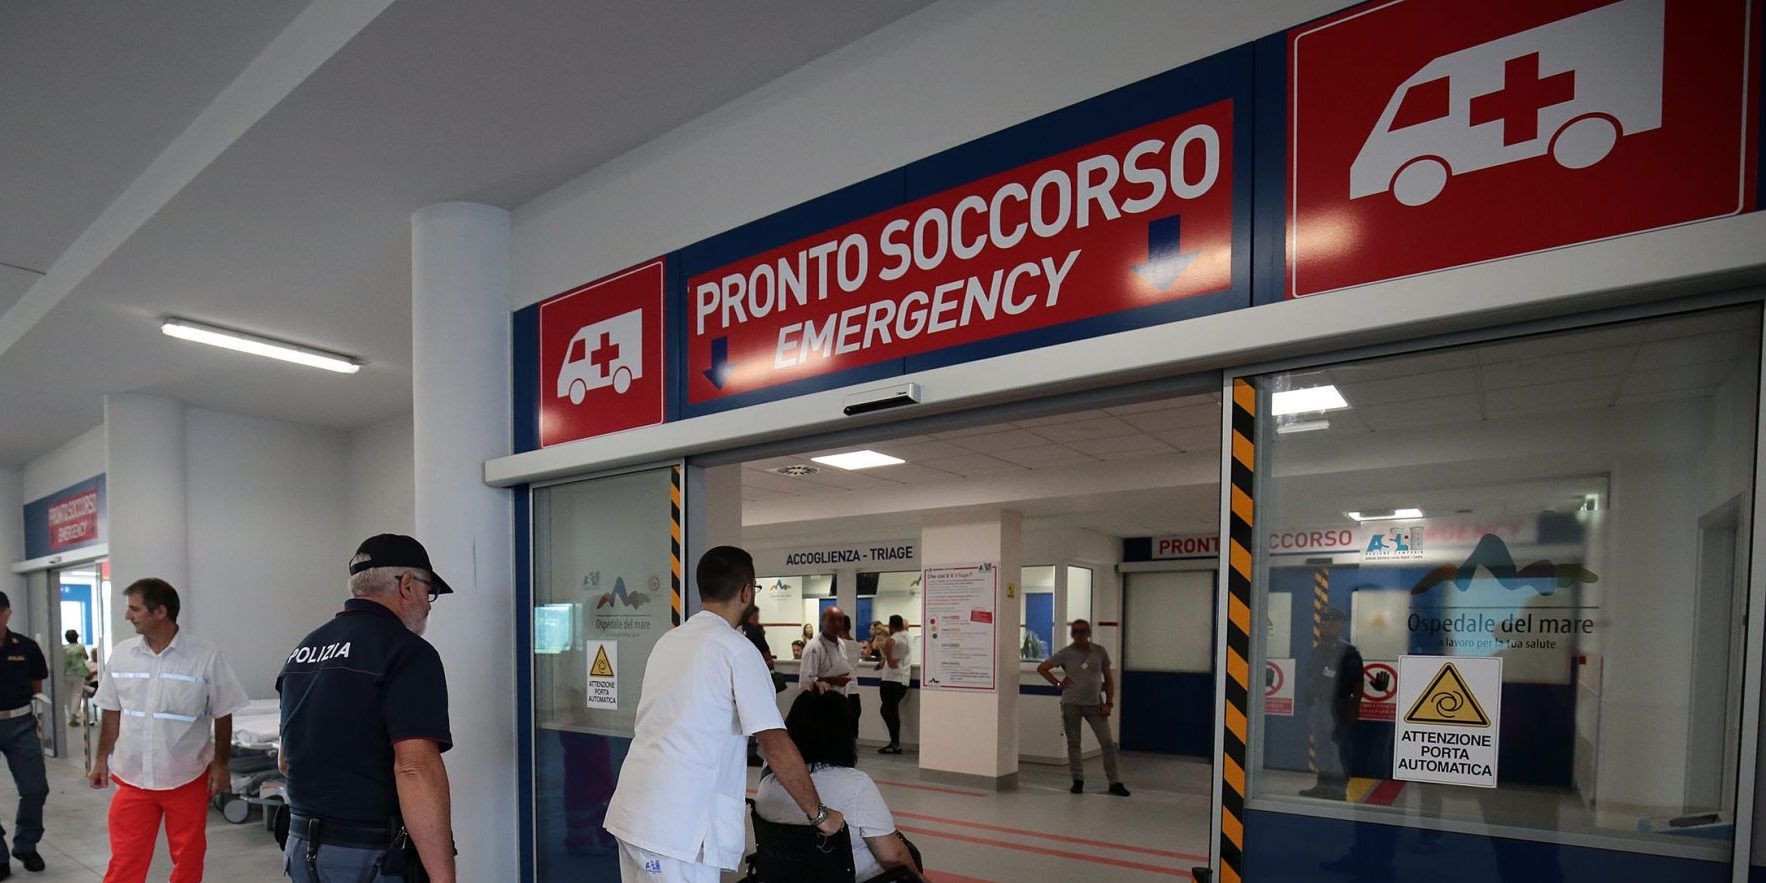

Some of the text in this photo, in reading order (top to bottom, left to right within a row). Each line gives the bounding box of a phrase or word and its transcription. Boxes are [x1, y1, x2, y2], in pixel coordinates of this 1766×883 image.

[696, 124, 1220, 335] PRONTO SOCCORSO
[773, 249, 1082, 369] EMERGENCY
[1159, 530, 1352, 555] PRONT CCORSO
[786, 550, 860, 566] ACCOGLIENZA
[870, 546, 913, 560] TRIAGE
[1407, 613, 1594, 636] Ospedale del mare
[287, 642, 351, 664] POLIZIA
[1445, 639, 1475, 649] lavoro
[1476, 641, 1492, 650] per
[1507, 641, 1523, 649] tua
[1525, 639, 1557, 649] salute
[588, 695, 616, 703] AUTOMATICA
[1401, 730, 1491, 747] ATTENZIONE
[1421, 746, 1469, 760] PORTA
[1398, 758, 1492, 776] AUTOMATICA
